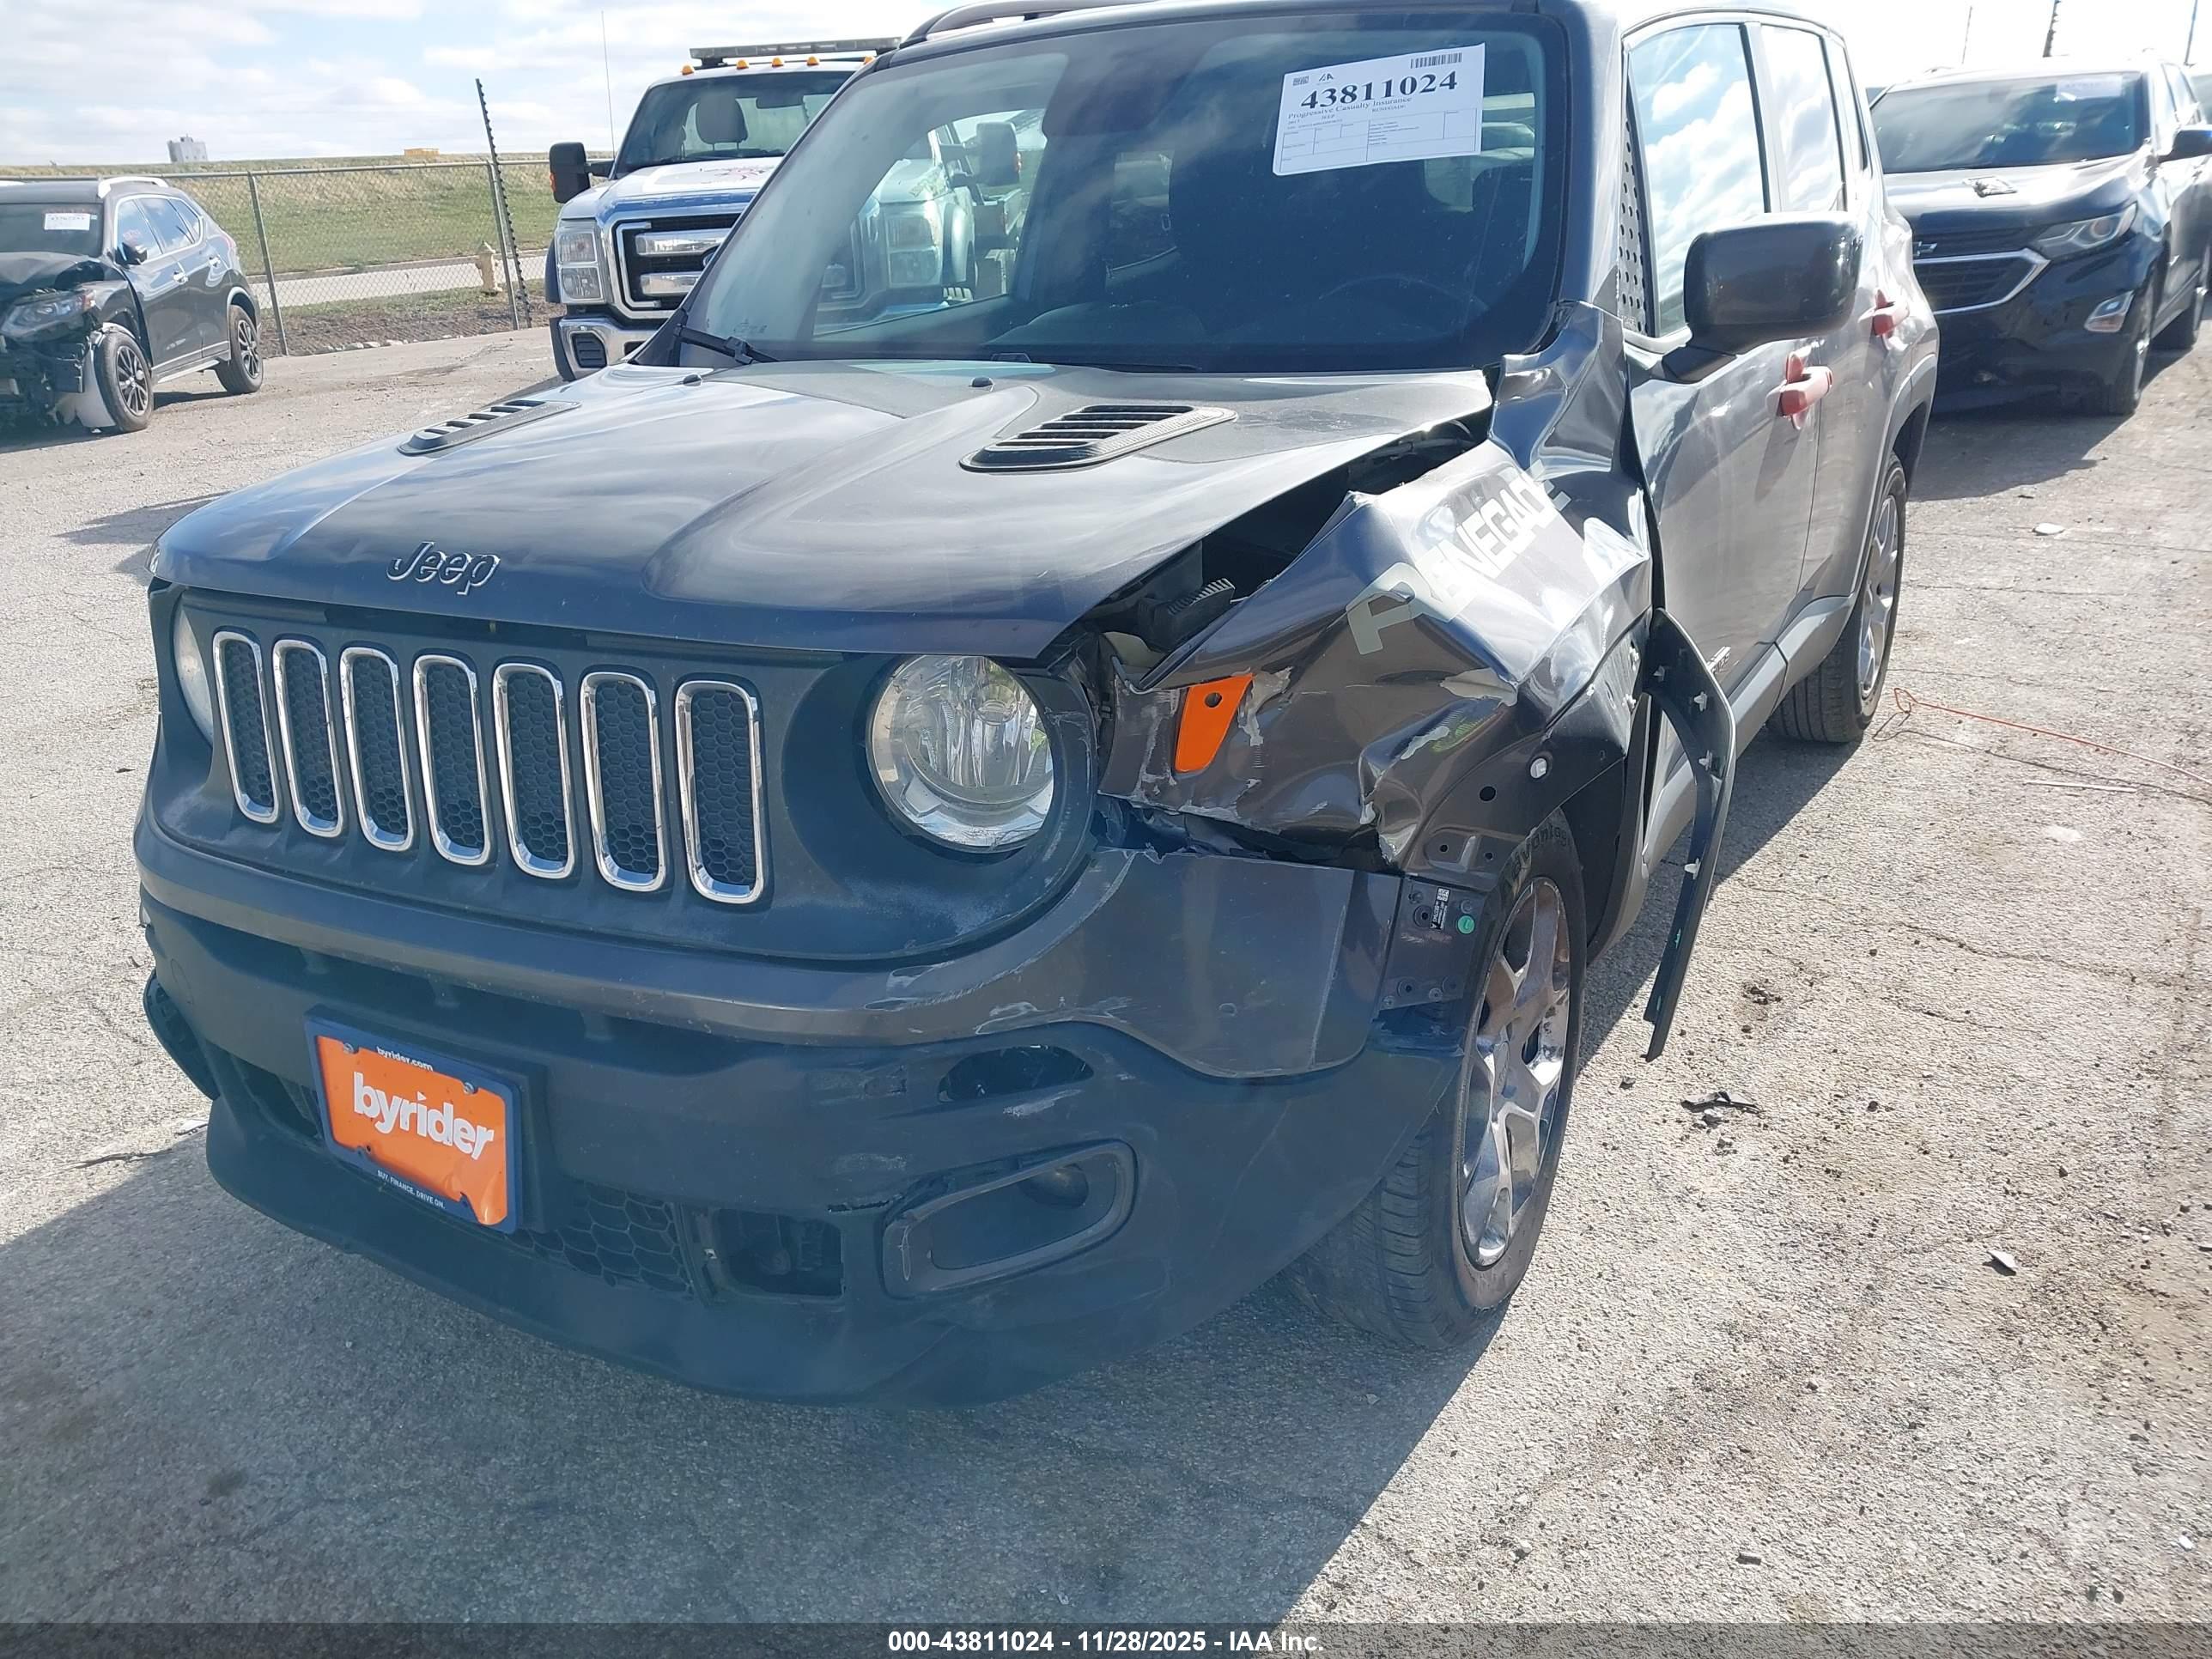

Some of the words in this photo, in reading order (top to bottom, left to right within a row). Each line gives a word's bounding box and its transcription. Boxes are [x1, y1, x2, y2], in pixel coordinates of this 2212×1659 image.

[1301, 70, 1458, 109] 43811024
[1287, 108, 1334, 119] Progressive
[1335, 101, 1370, 112] Casualty
[1373, 97, 1413, 106] Insurance
[386, 541, 501, 595] Jeep
[376, 1046, 434, 1072] byrider.com
[353, 1071, 495, 1160] byrider
[390, 1176, 416, 1196] FINANCE.
[416, 1189, 434, 1205] DRIVE
